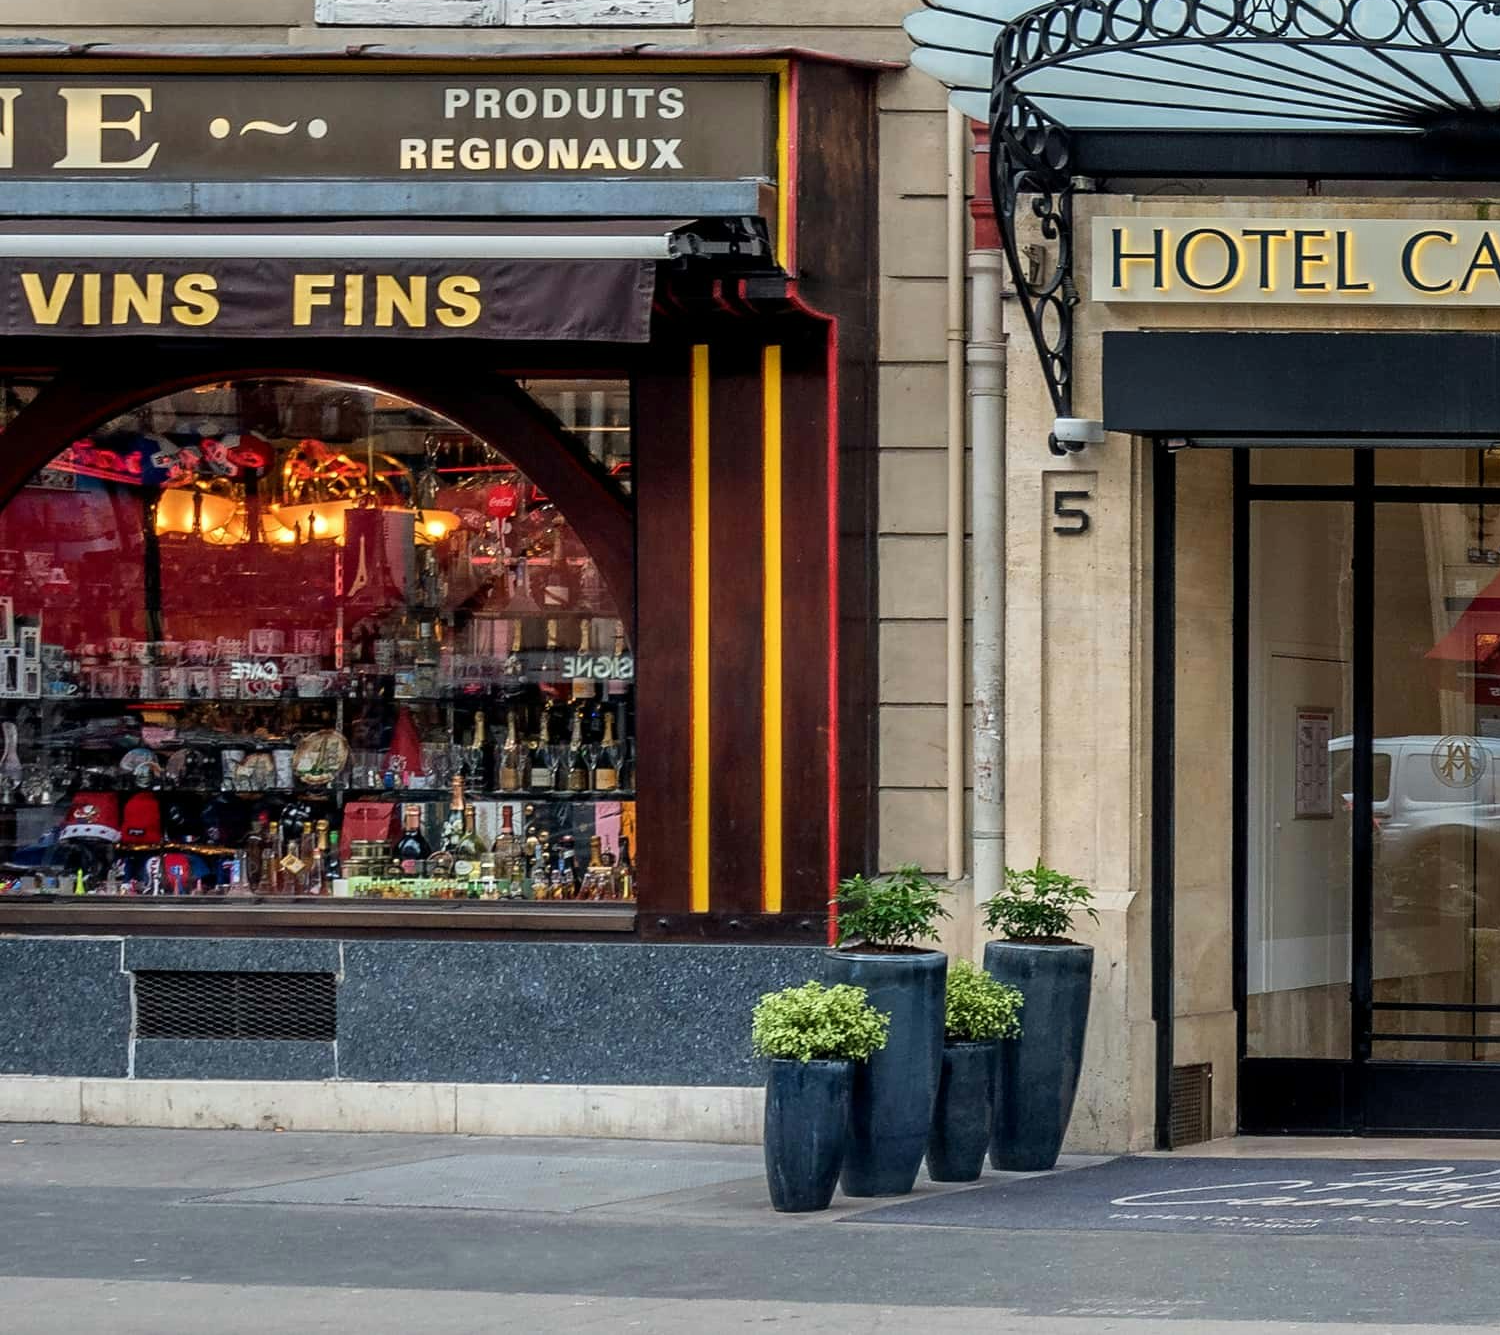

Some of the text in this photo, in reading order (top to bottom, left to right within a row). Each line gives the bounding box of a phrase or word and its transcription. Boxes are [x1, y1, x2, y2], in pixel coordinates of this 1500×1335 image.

[0, 87, 160, 169] E
[444, 87, 686, 120] PRODUITS
[400, 137, 685, 171] REGIONAUX
[1111, 227, 1375, 293] HOTEL
[20, 272, 484, 328] VINS FINS
[1053, 490, 1089, 536] 5
